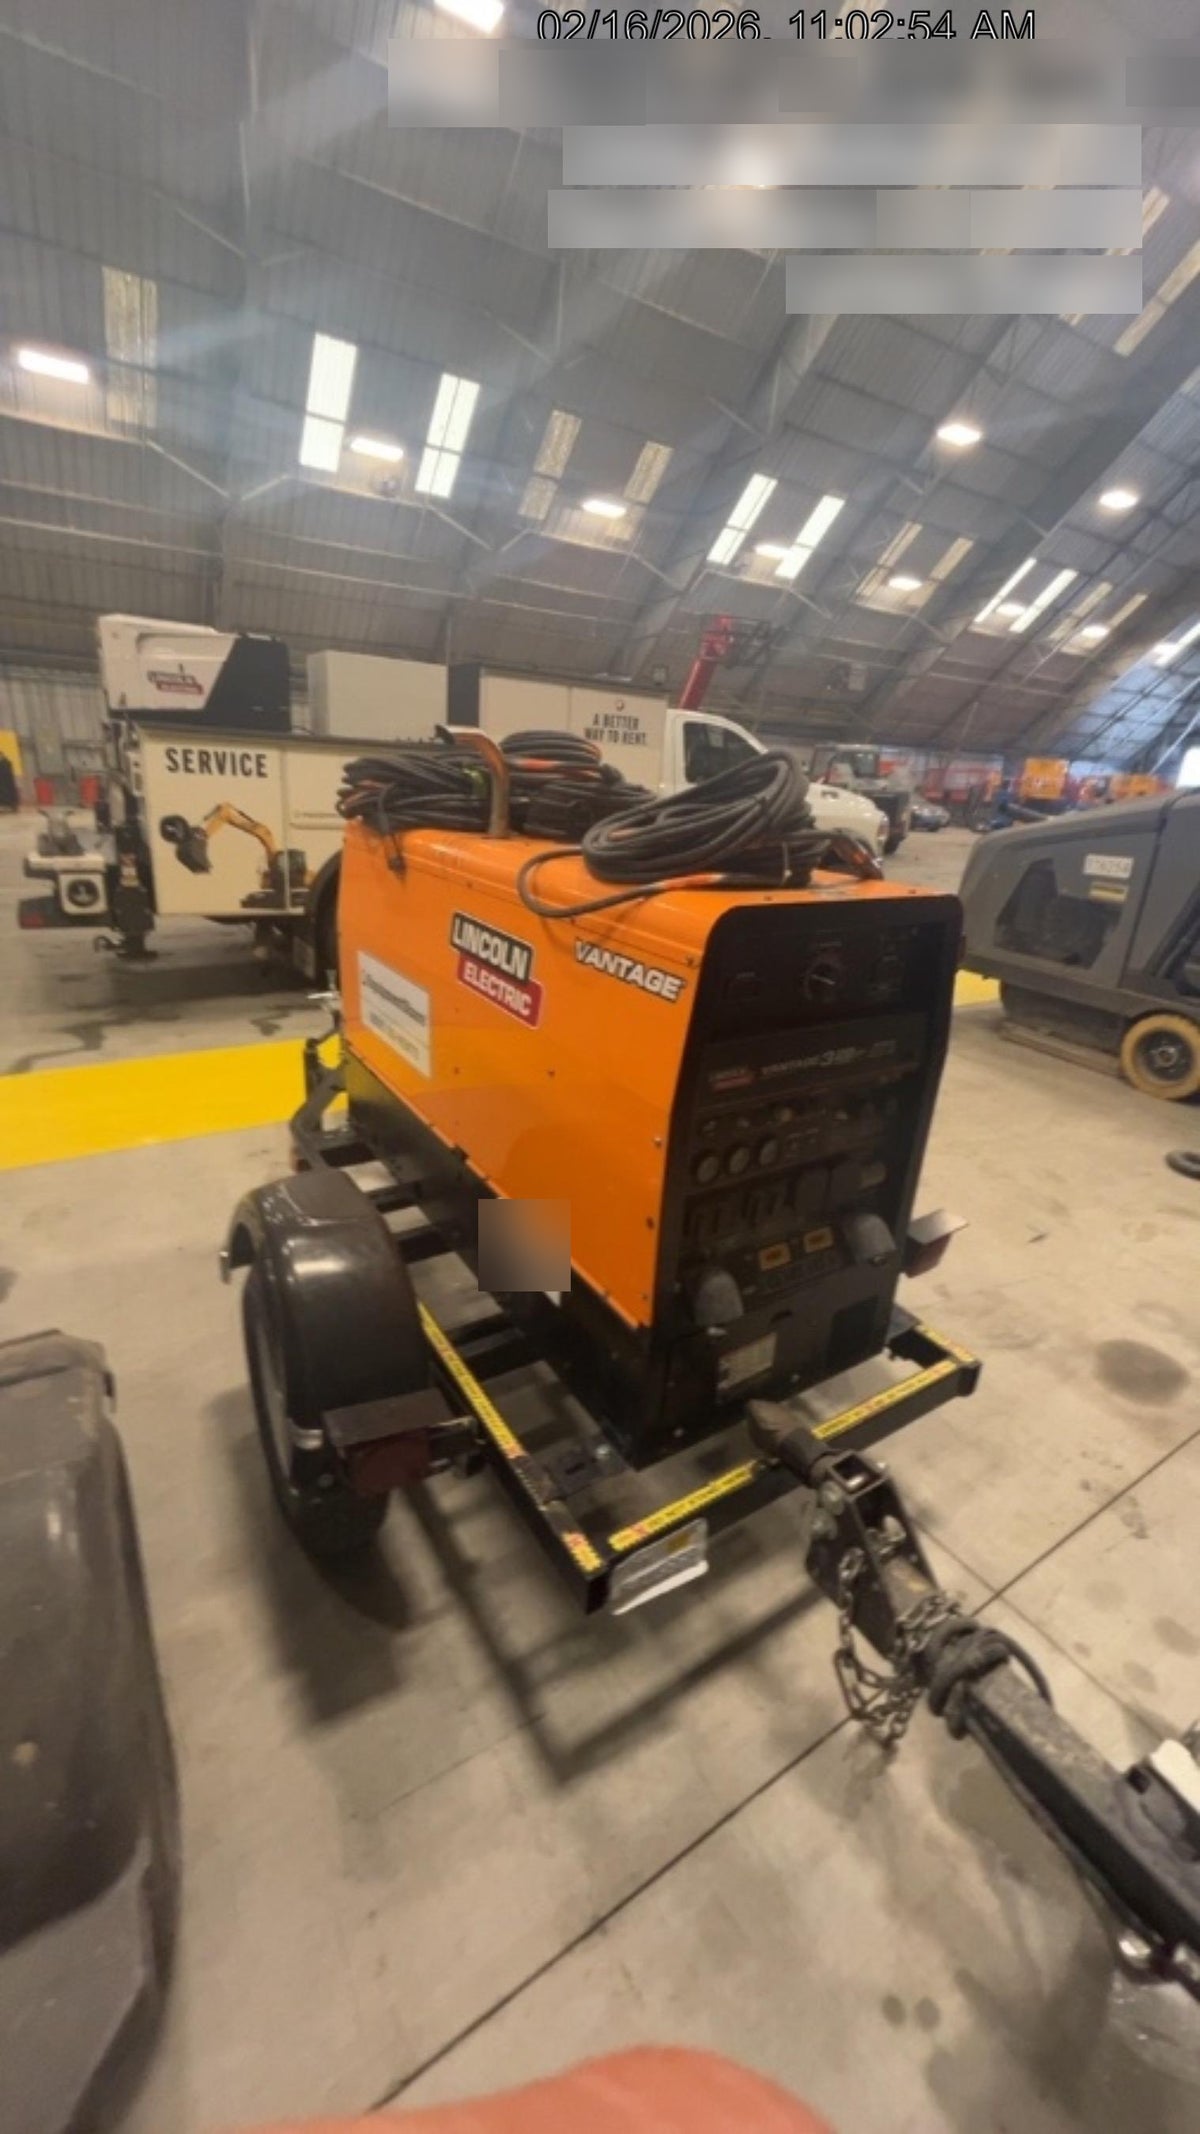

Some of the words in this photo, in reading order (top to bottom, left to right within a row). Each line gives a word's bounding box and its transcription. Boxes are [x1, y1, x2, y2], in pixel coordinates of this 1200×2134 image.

[584, 727, 604, 741] WAY
[608, 730, 619, 744] TO
[592, 713, 599, 726] A
[604, 713, 639, 730] BETTER
[165, 746, 268, 779] SERVICE
[454, 916, 530, 981] LINCOLN
[574, 938, 683, 1001] VANTAGE
[462, 961, 533, 1017] ELECTRIC
